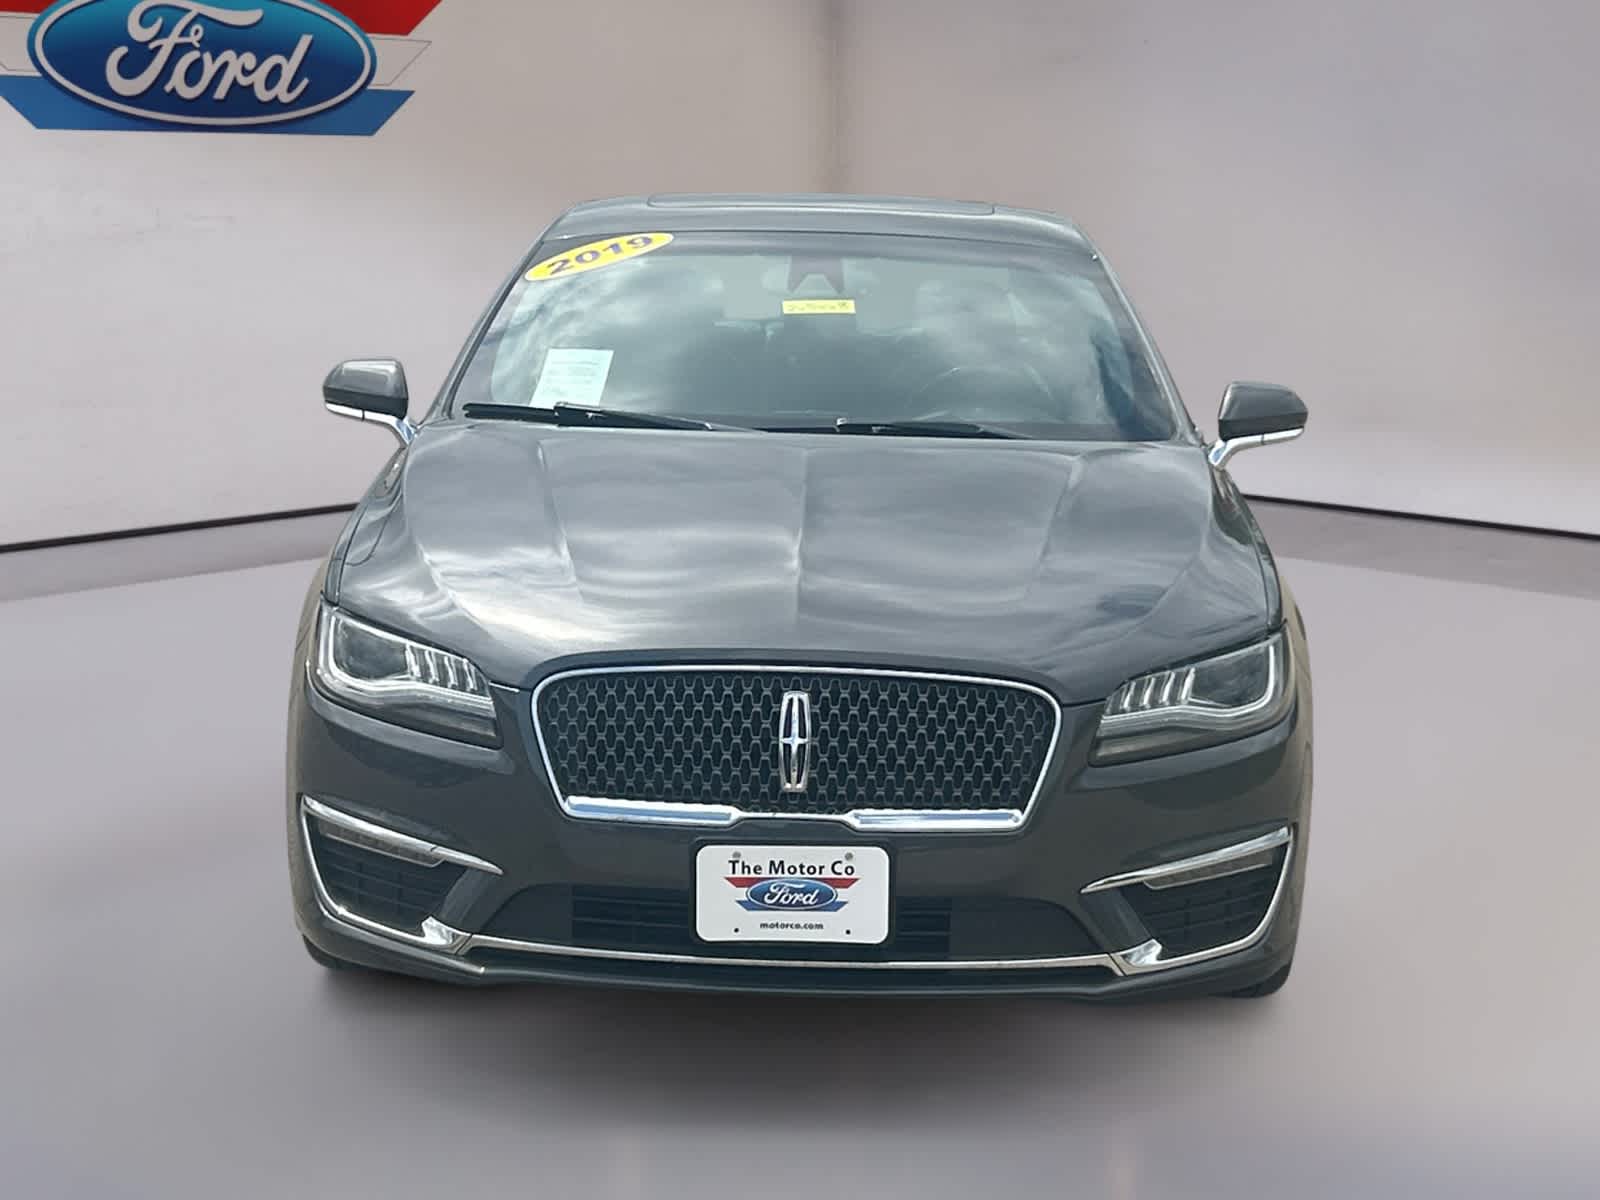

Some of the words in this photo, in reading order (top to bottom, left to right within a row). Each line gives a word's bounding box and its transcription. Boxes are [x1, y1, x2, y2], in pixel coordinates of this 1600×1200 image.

[105, 0, 313, 103] Ford
[547, 236, 653, 275] 2019
[728, 860, 763, 876] The
[768, 860, 825, 876] Motor
[831, 860, 855, 876] Co
[764, 883, 819, 905] Ford
[759, 922, 824, 930] motorco.com
